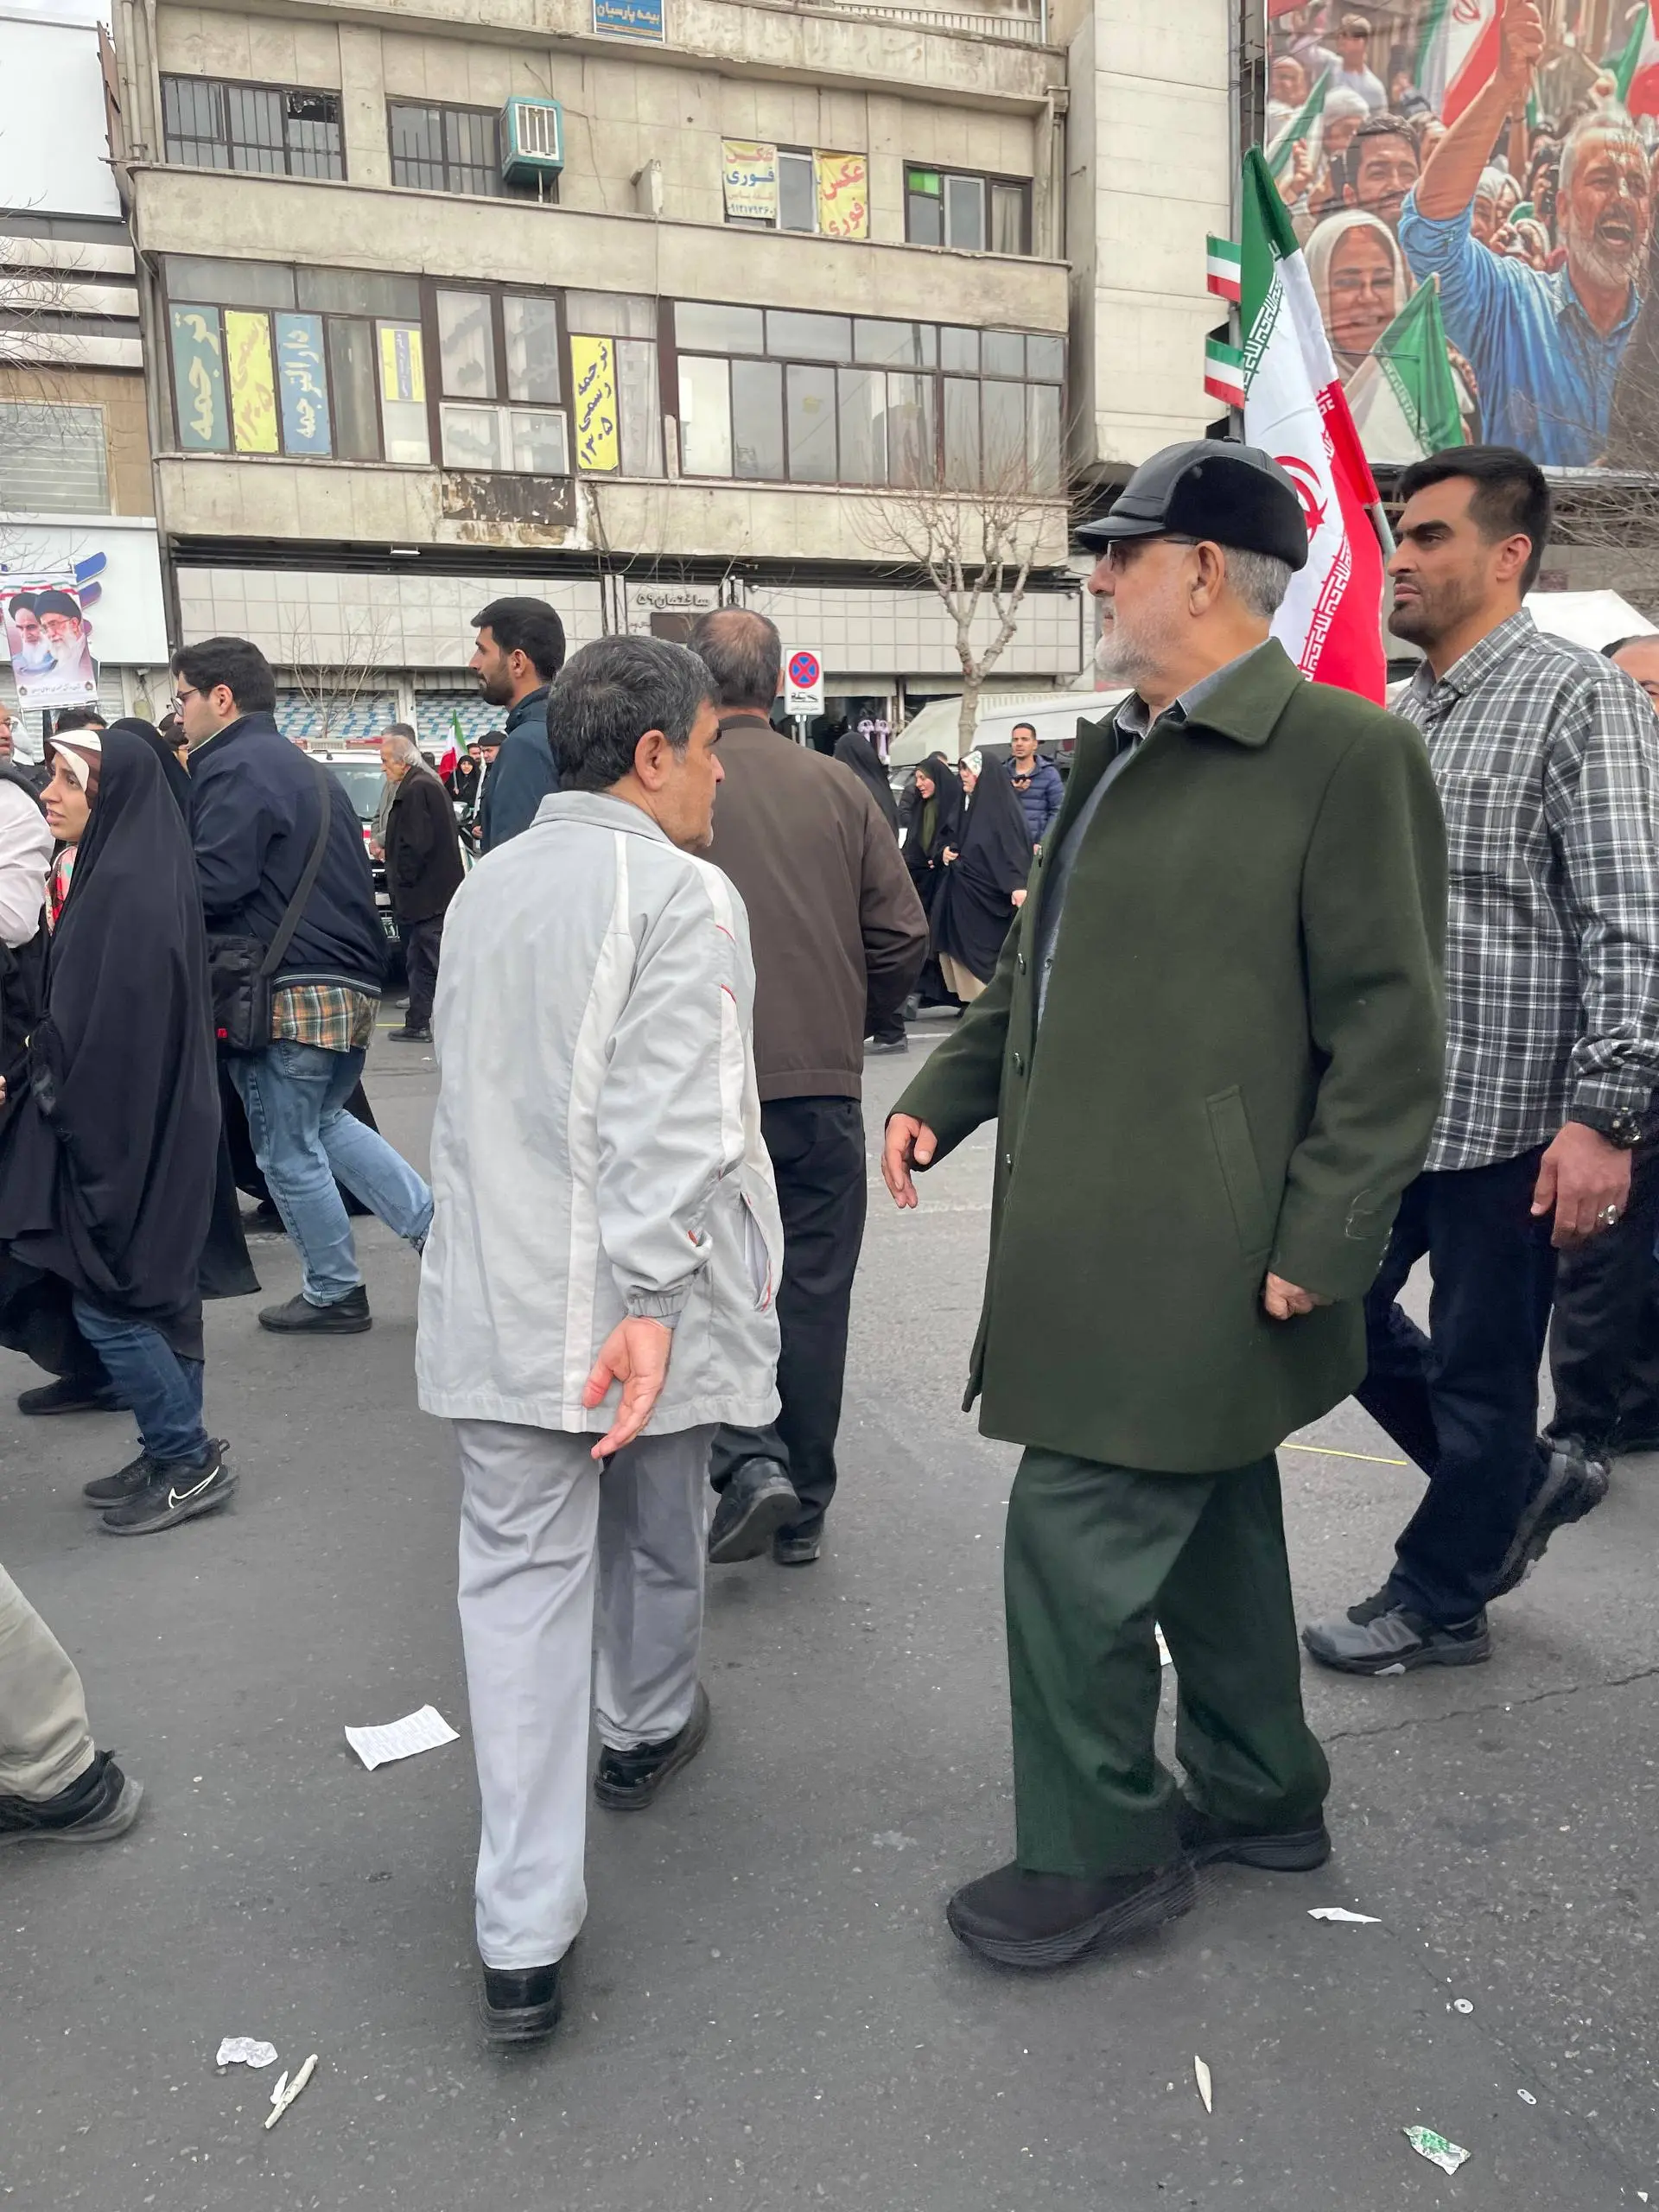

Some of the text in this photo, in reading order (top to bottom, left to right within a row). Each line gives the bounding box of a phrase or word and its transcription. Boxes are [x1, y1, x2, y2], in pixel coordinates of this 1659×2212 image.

[596, 1, 660, 25] بیمه پارسیان
[726, 146, 774, 164] عکس
[726, 166, 775, 188] فوری
[822, 163, 865, 200] عکس
[828, 196, 865, 236] فوری
[232, 317, 267, 391] رسمی
[577, 340, 608, 396] ترجمه
[175, 312, 220, 442] ترجمه
[578, 382, 612, 433] رسمی
[637, 593, 709, 608] ساختمان ۵۹
